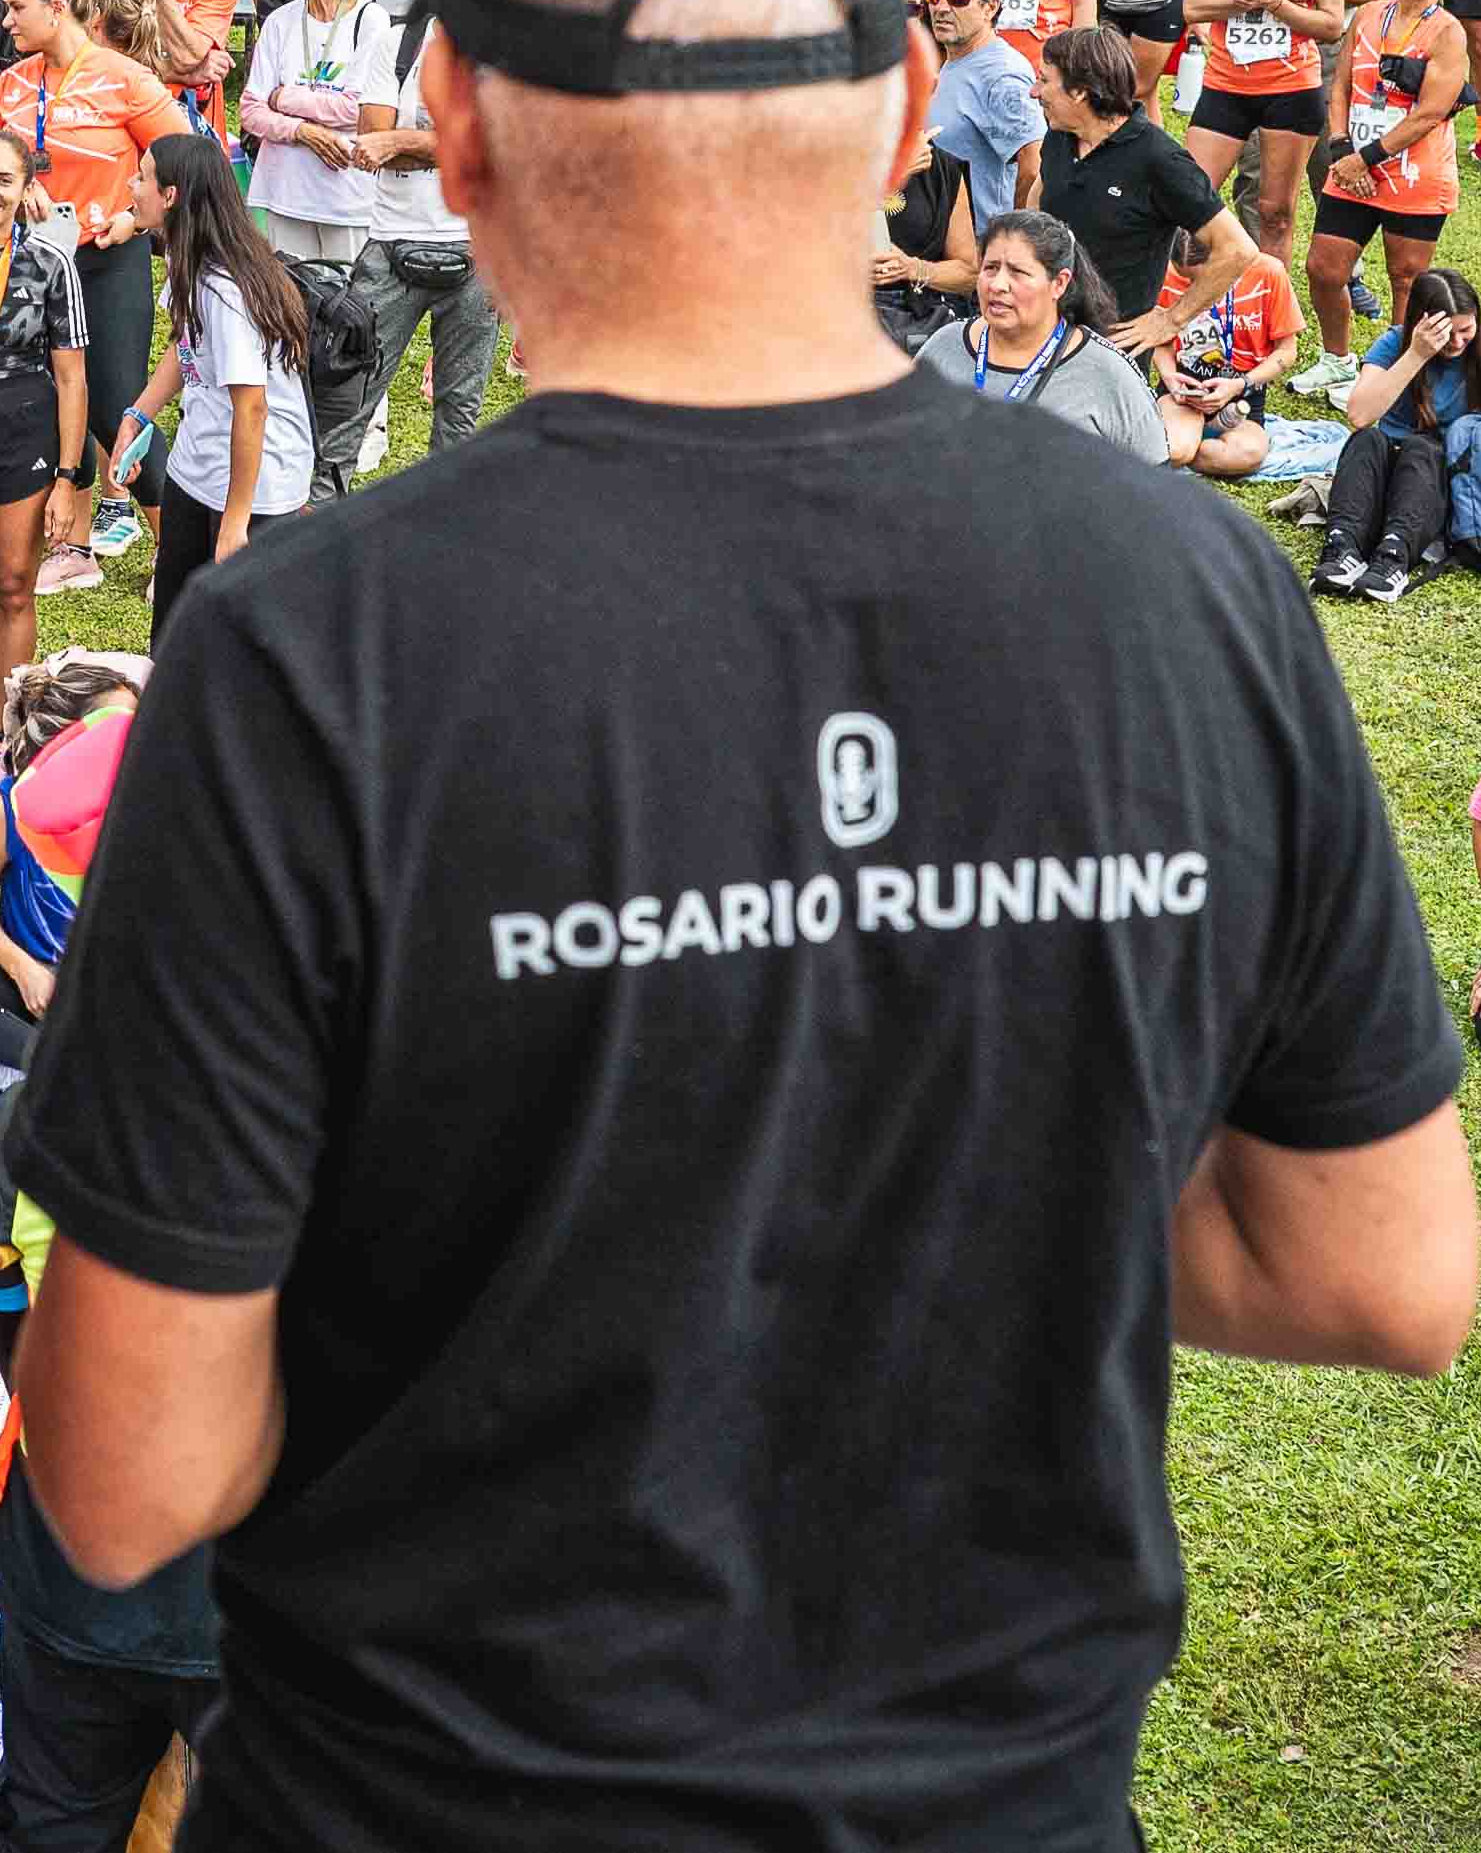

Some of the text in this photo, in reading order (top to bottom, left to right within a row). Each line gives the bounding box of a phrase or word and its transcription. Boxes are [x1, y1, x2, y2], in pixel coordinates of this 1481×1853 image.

[1228, 27, 1288, 45] 5262
[489, 850, 1208, 980] ROSARIO RUNNING
